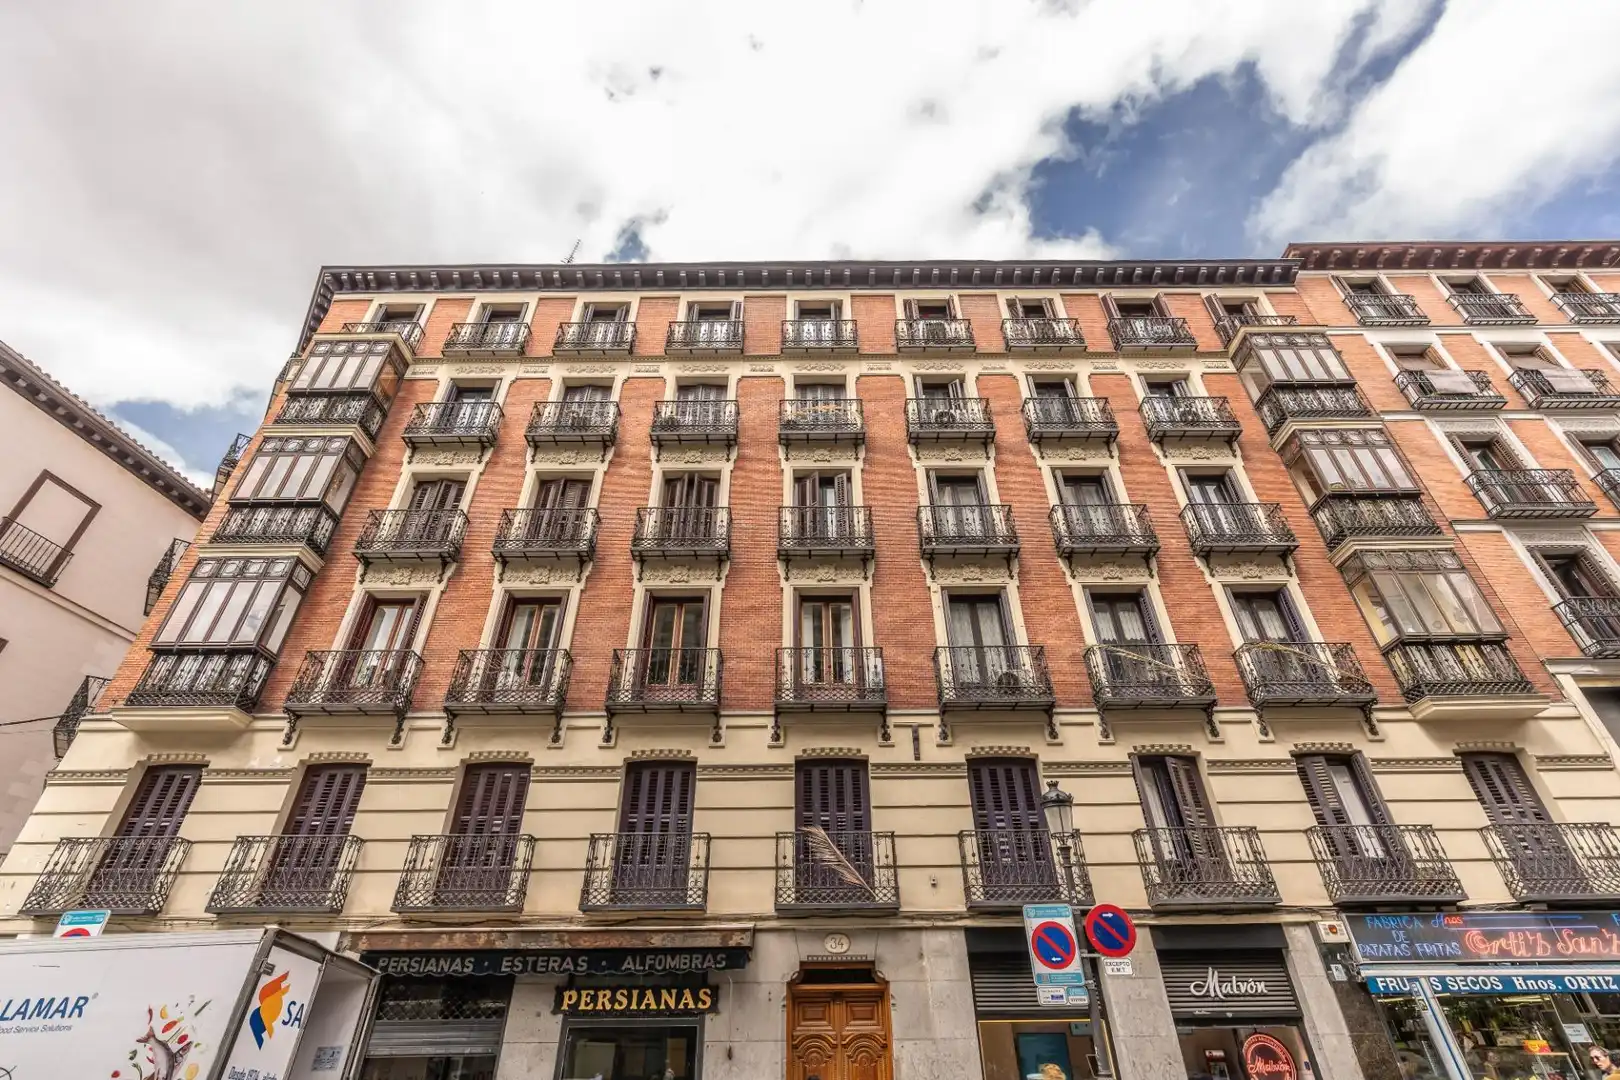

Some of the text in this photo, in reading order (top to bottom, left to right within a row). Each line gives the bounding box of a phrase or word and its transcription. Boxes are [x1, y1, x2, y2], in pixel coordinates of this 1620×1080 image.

[1364, 916, 1424, 930] FABRICA
[830, 937, 845, 950] 34
[1391, 930, 1409, 944] DE
[1358, 942, 1462, 957] PATATAS FRITAS
[378, 953, 727, 973] PERSIANAS ESTERAS ALFOMBRAS
[1190, 966, 1268, 999] Malvón
[1376, 976, 1619, 991] FRUS SECOS Hnos. ORTIZ
[561, 988, 713, 1011] PERSIANAS
